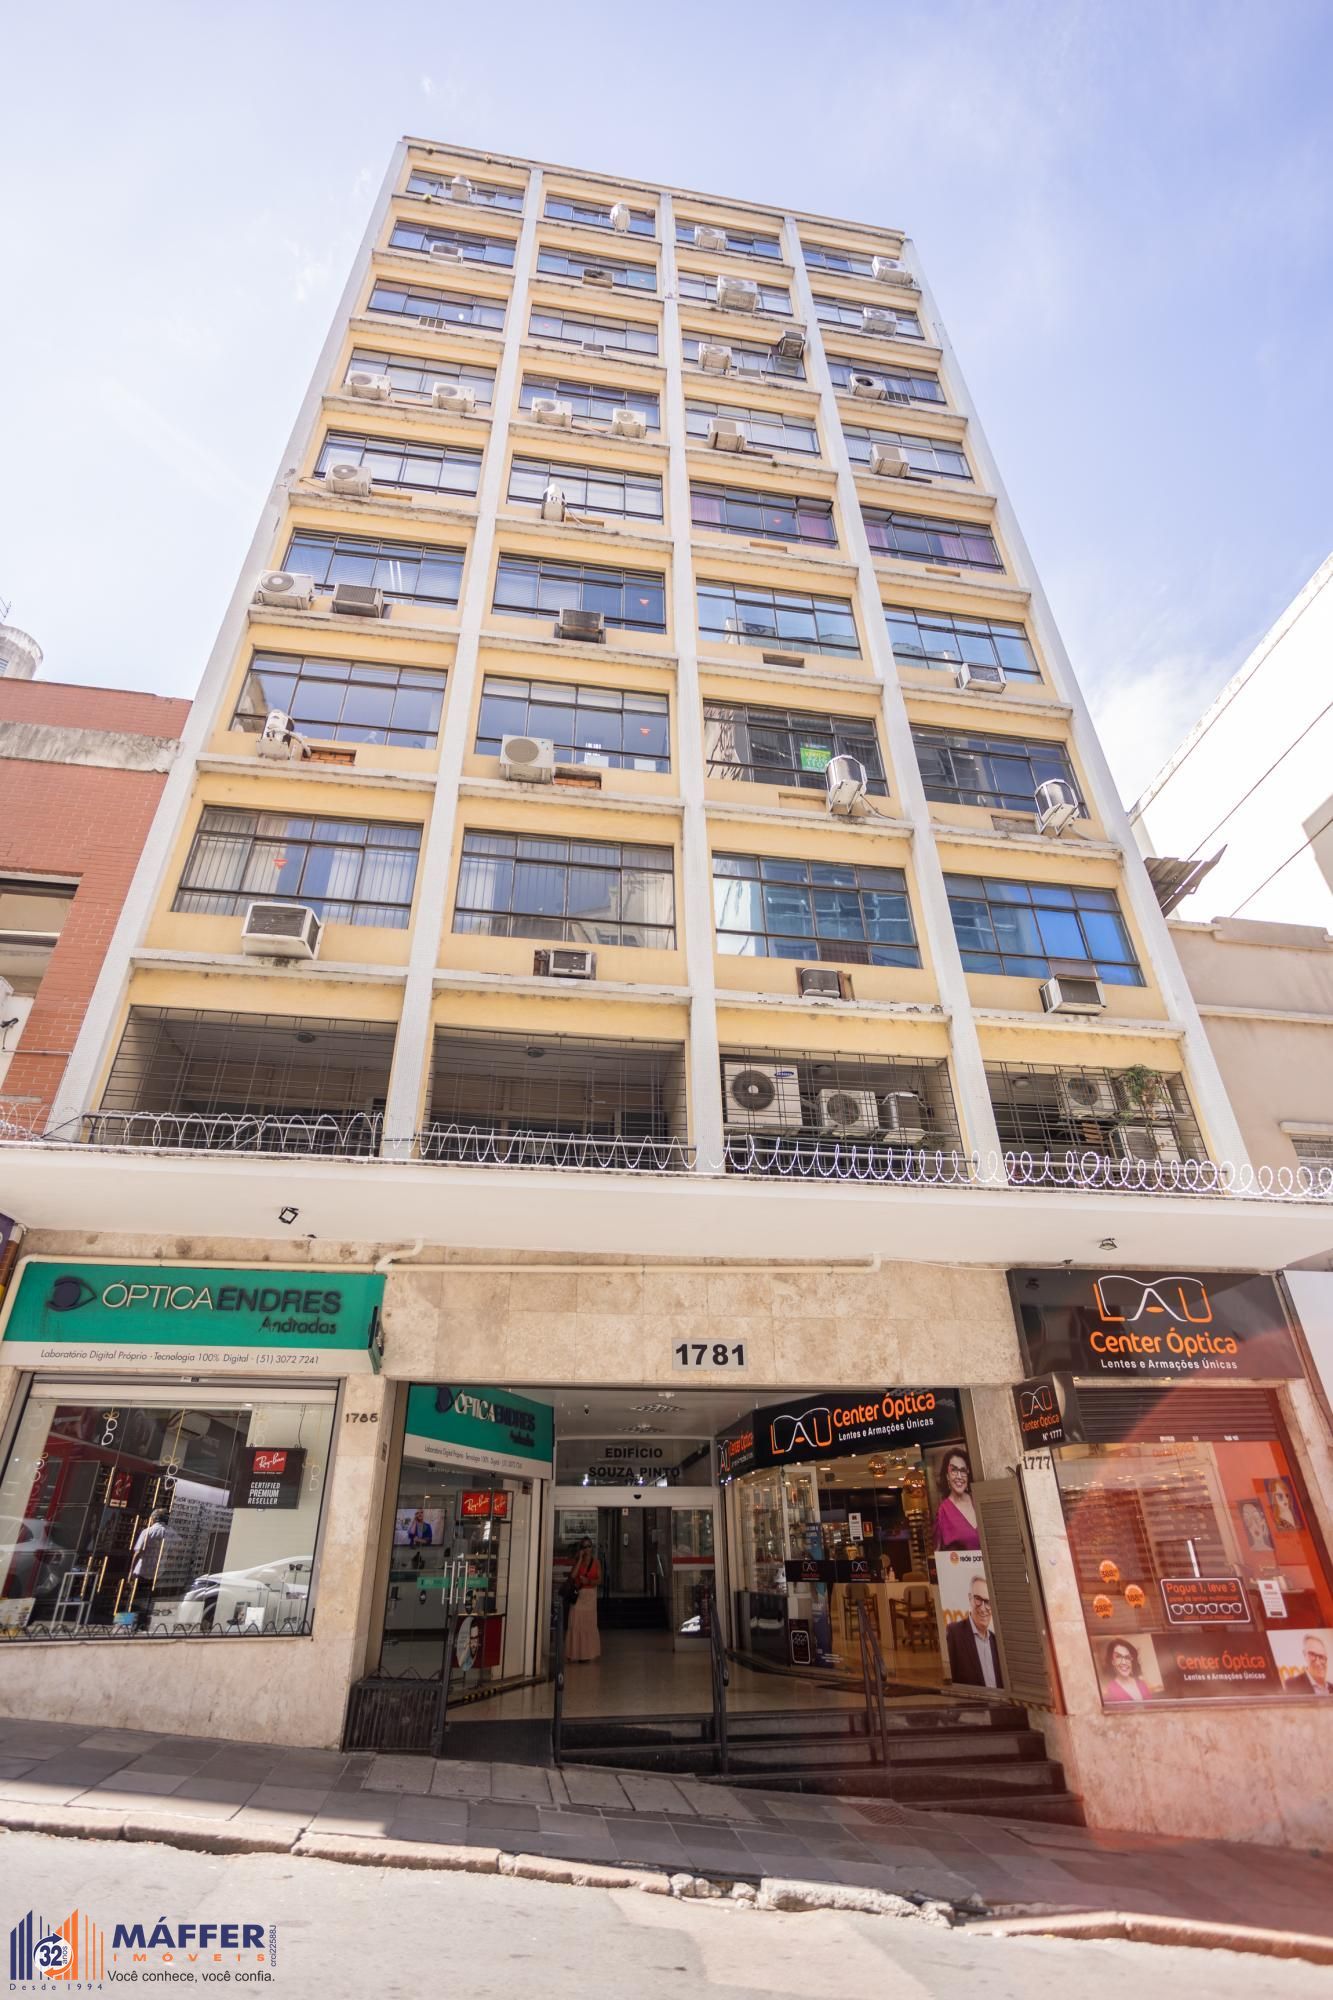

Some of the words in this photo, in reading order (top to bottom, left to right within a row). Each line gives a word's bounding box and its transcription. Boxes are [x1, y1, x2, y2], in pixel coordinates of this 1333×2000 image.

[1090, 1331, 1161, 1353] Center
[1166, 1327, 1238, 1359] Óptica
[40, 1349, 88, 1359] Laboratório
[89, 1350, 116, 1361] Digital
[117, 1351, 148, 1361] Próprio
[154, 1352, 195, 1363] Tecnologia
[198, 1353, 220, 1362] 100%
[223, 1354, 249, 1364] Digital
[256, 1354, 274, 1364] (51)
[275, 1355, 296, 1363] 3072
[299, 1355, 319, 1364] 7241
[676, 1344, 744, 1365] 1781
[1101, 1359, 1137, 1369] Lentes
[1148, 1359, 1200, 1371] Armações
[1202, 1357, 1238, 1369] Únicas
[833, 1404, 880, 1428] Center
[882, 1392, 936, 1420] Óptica
[838, 1428, 861, 1442] Lentes
[868, 1423, 905, 1436] Armações
[906, 1417, 934, 1430] Únicas
[1022, 1419, 1039, 1432] Center
[1023, 1456, 1050, 1470] 1777
[588, 1466, 633, 1478] SOUZA
[639, 1466, 680, 1478] PINTO
[249, 1489, 279, 1497] PREMIUM
[1166, 1583, 1197, 1595] Pague
[1207, 1583, 1228, 1593] leve
[1229, 1582, 1237, 1592] 3
[1176, 1653, 1220, 1670] Center
[1222, 1650, 1266, 1671] Óptica
[1184, 1673, 1206, 1681] Lentes
[1212, 1673, 1243, 1681] Armações
[1243, 1671, 1266, 1680] Únicas
